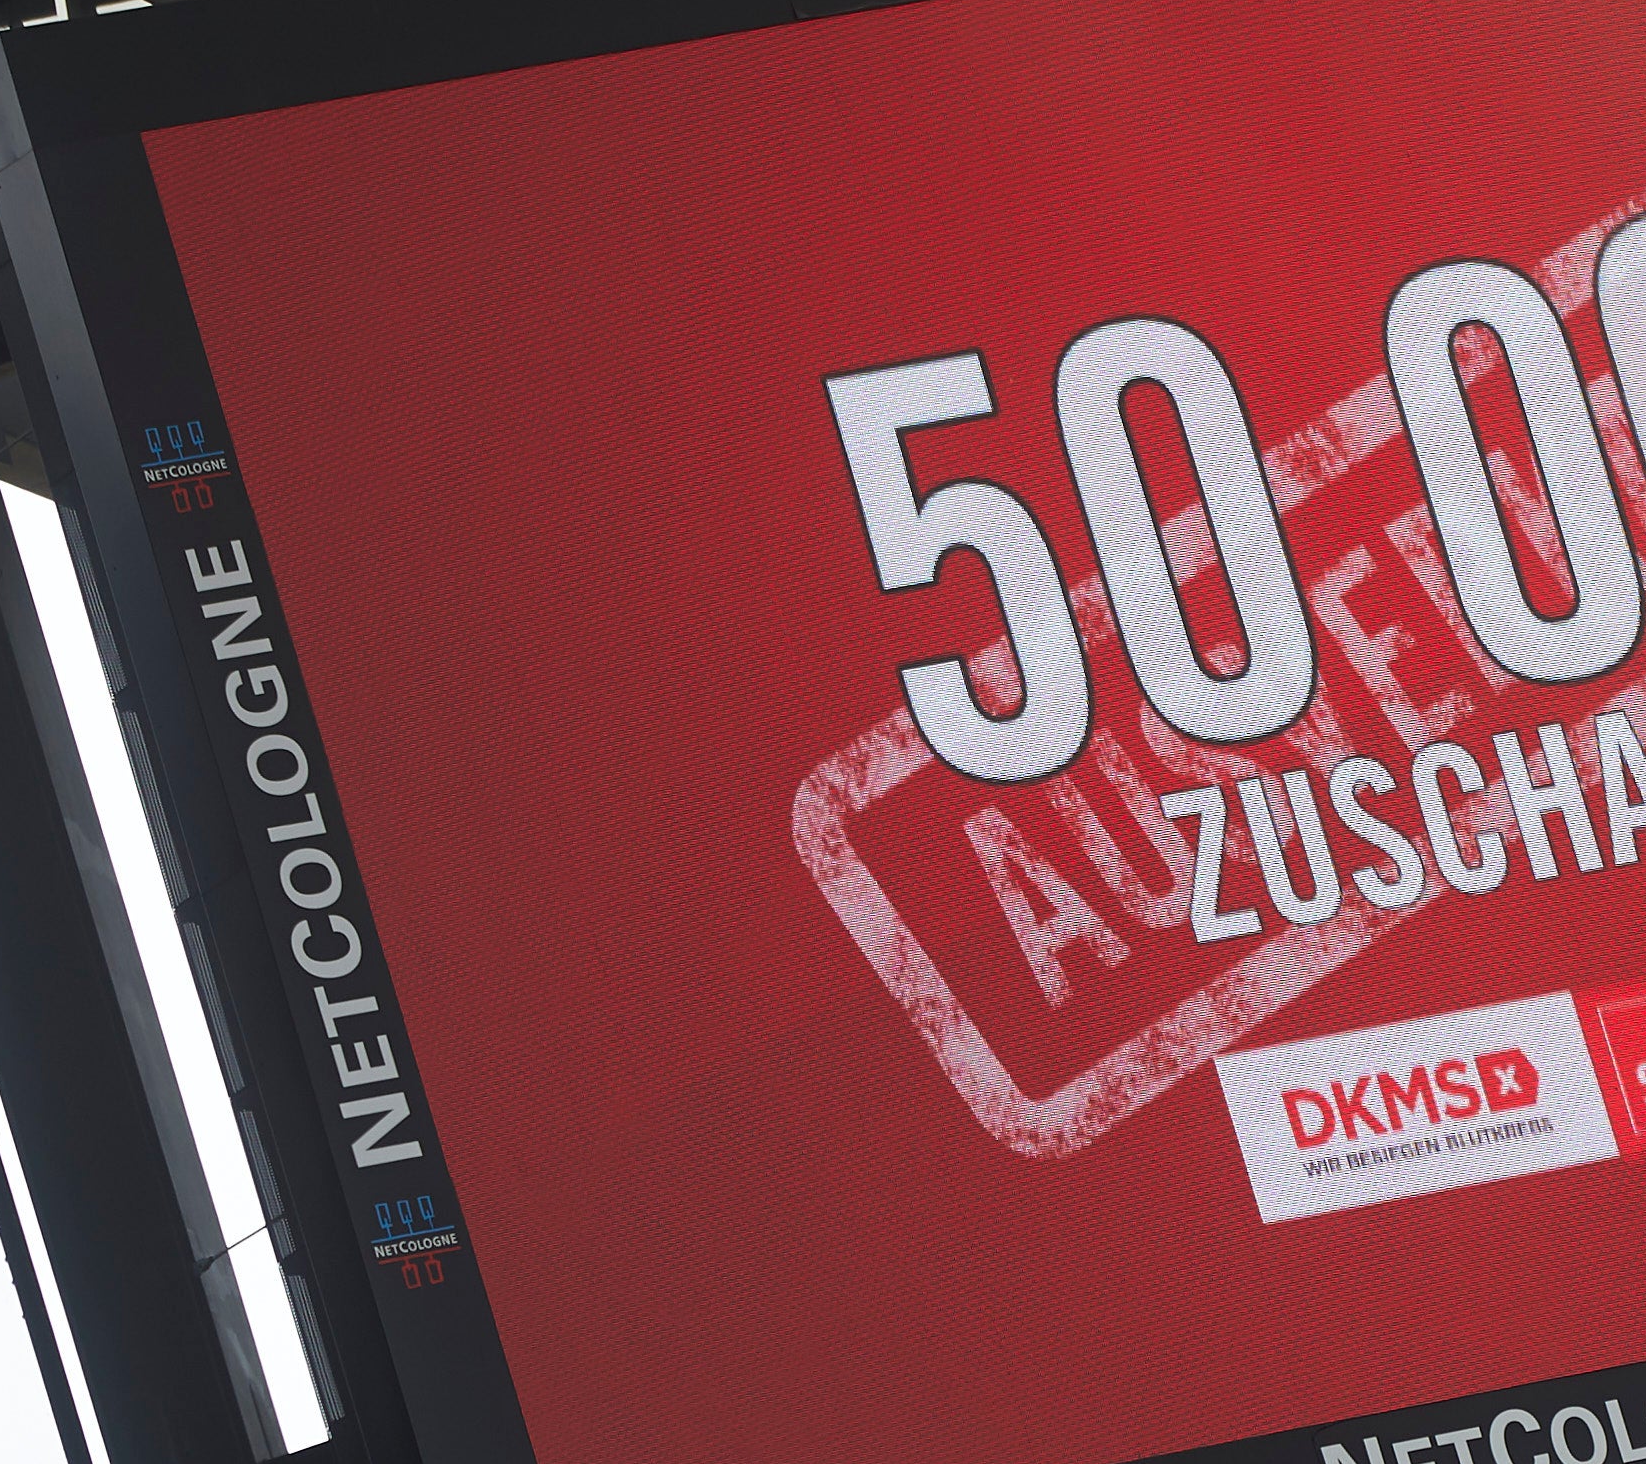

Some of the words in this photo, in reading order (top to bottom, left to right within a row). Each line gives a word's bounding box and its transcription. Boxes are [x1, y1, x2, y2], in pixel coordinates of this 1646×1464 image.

[143, 458, 228, 483] NETCOLOGNE
[822, 312, 1320, 788] 50
[185, 540, 424, 1171] NETCOLOGNE
[1282, 1058, 1483, 1151] DKMS
[373, 1232, 459, 1259] NETCOLOGNE
